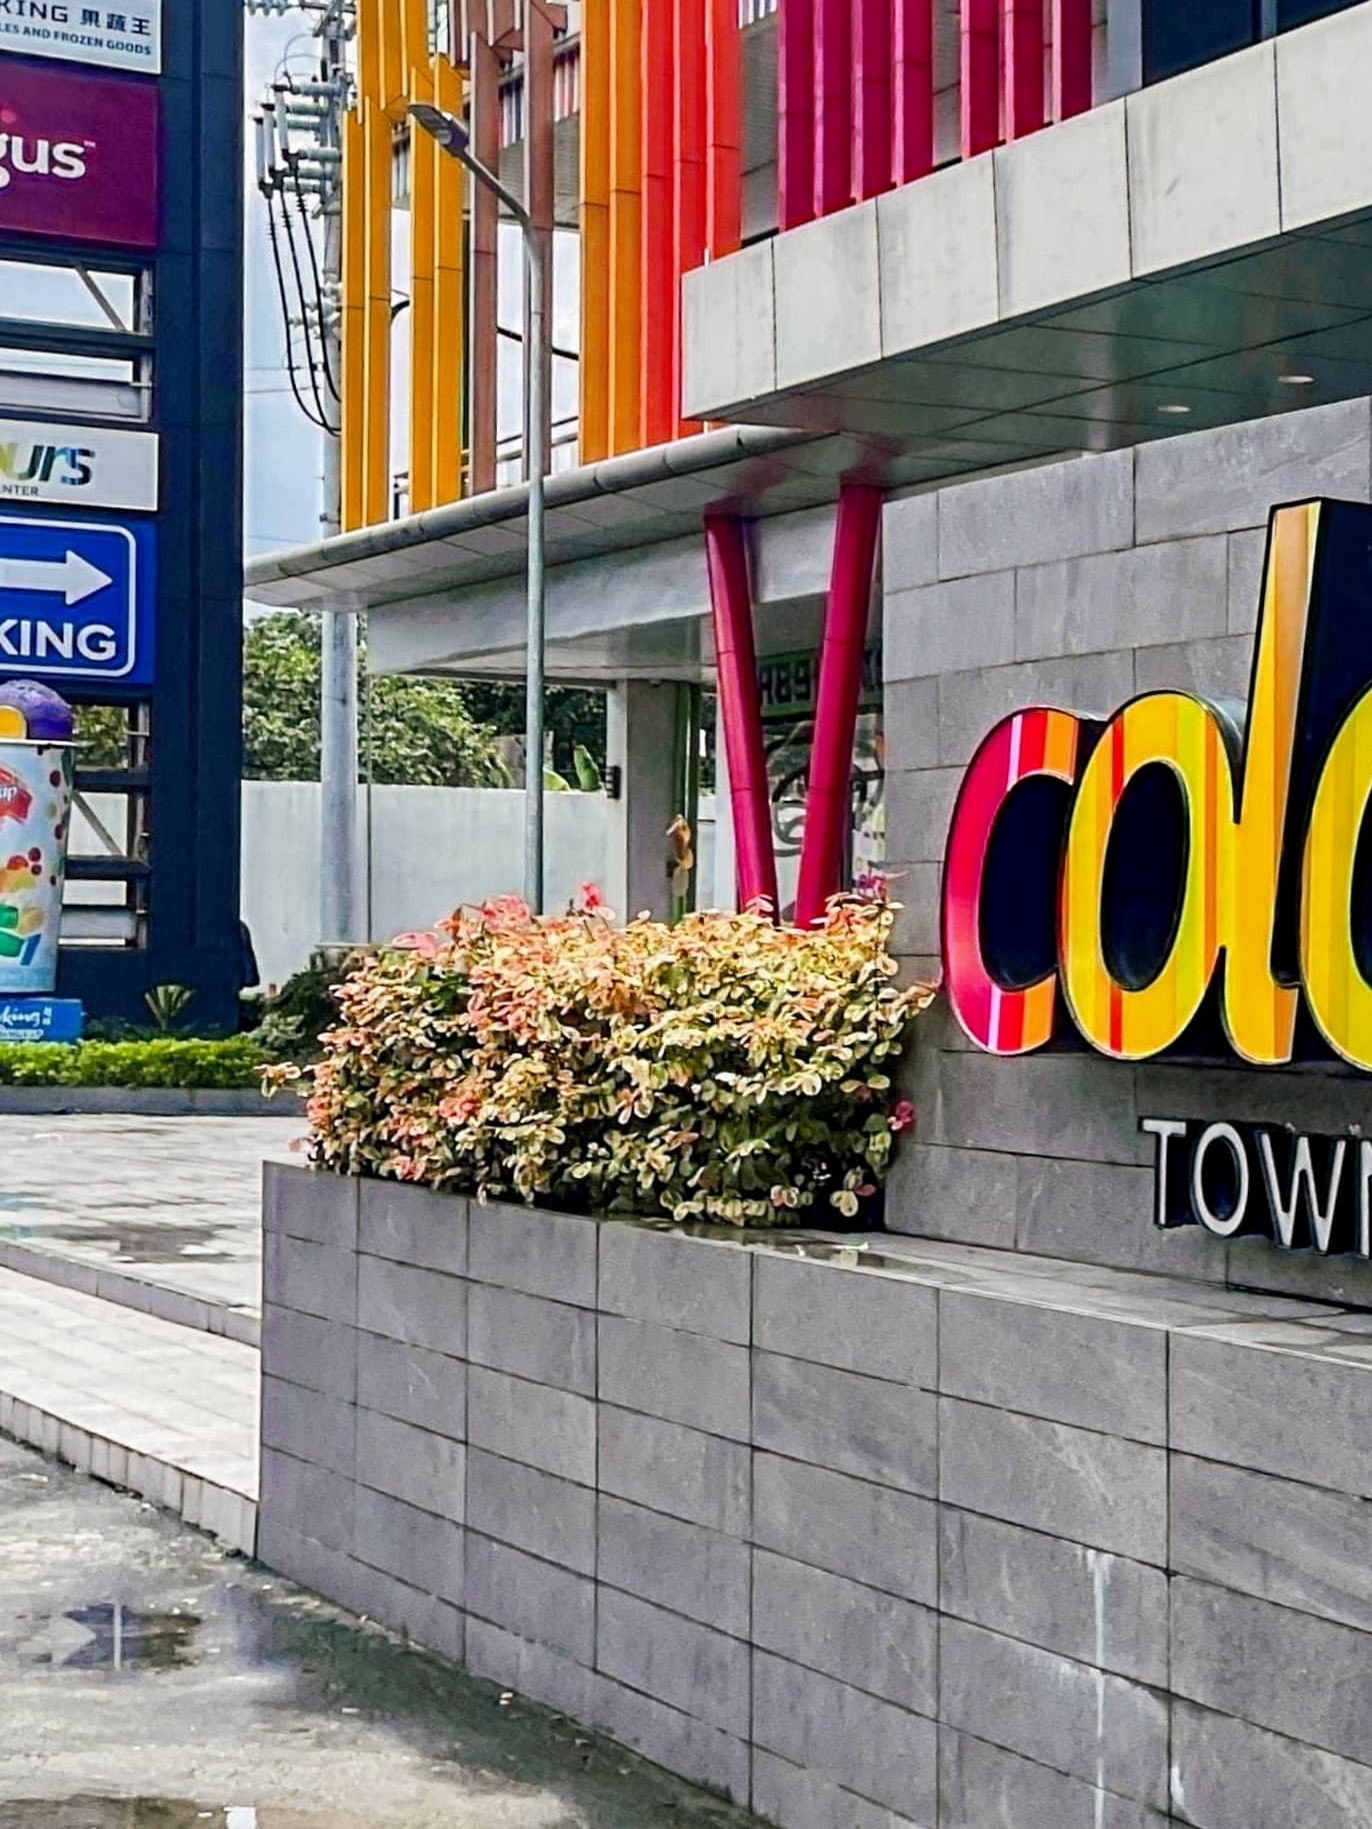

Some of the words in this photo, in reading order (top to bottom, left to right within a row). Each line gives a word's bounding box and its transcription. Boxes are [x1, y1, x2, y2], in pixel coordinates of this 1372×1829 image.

[22, 25, 50, 40] AND
[53, 30, 104, 49] FROZEN
[106, 38, 152, 56] GOODS
